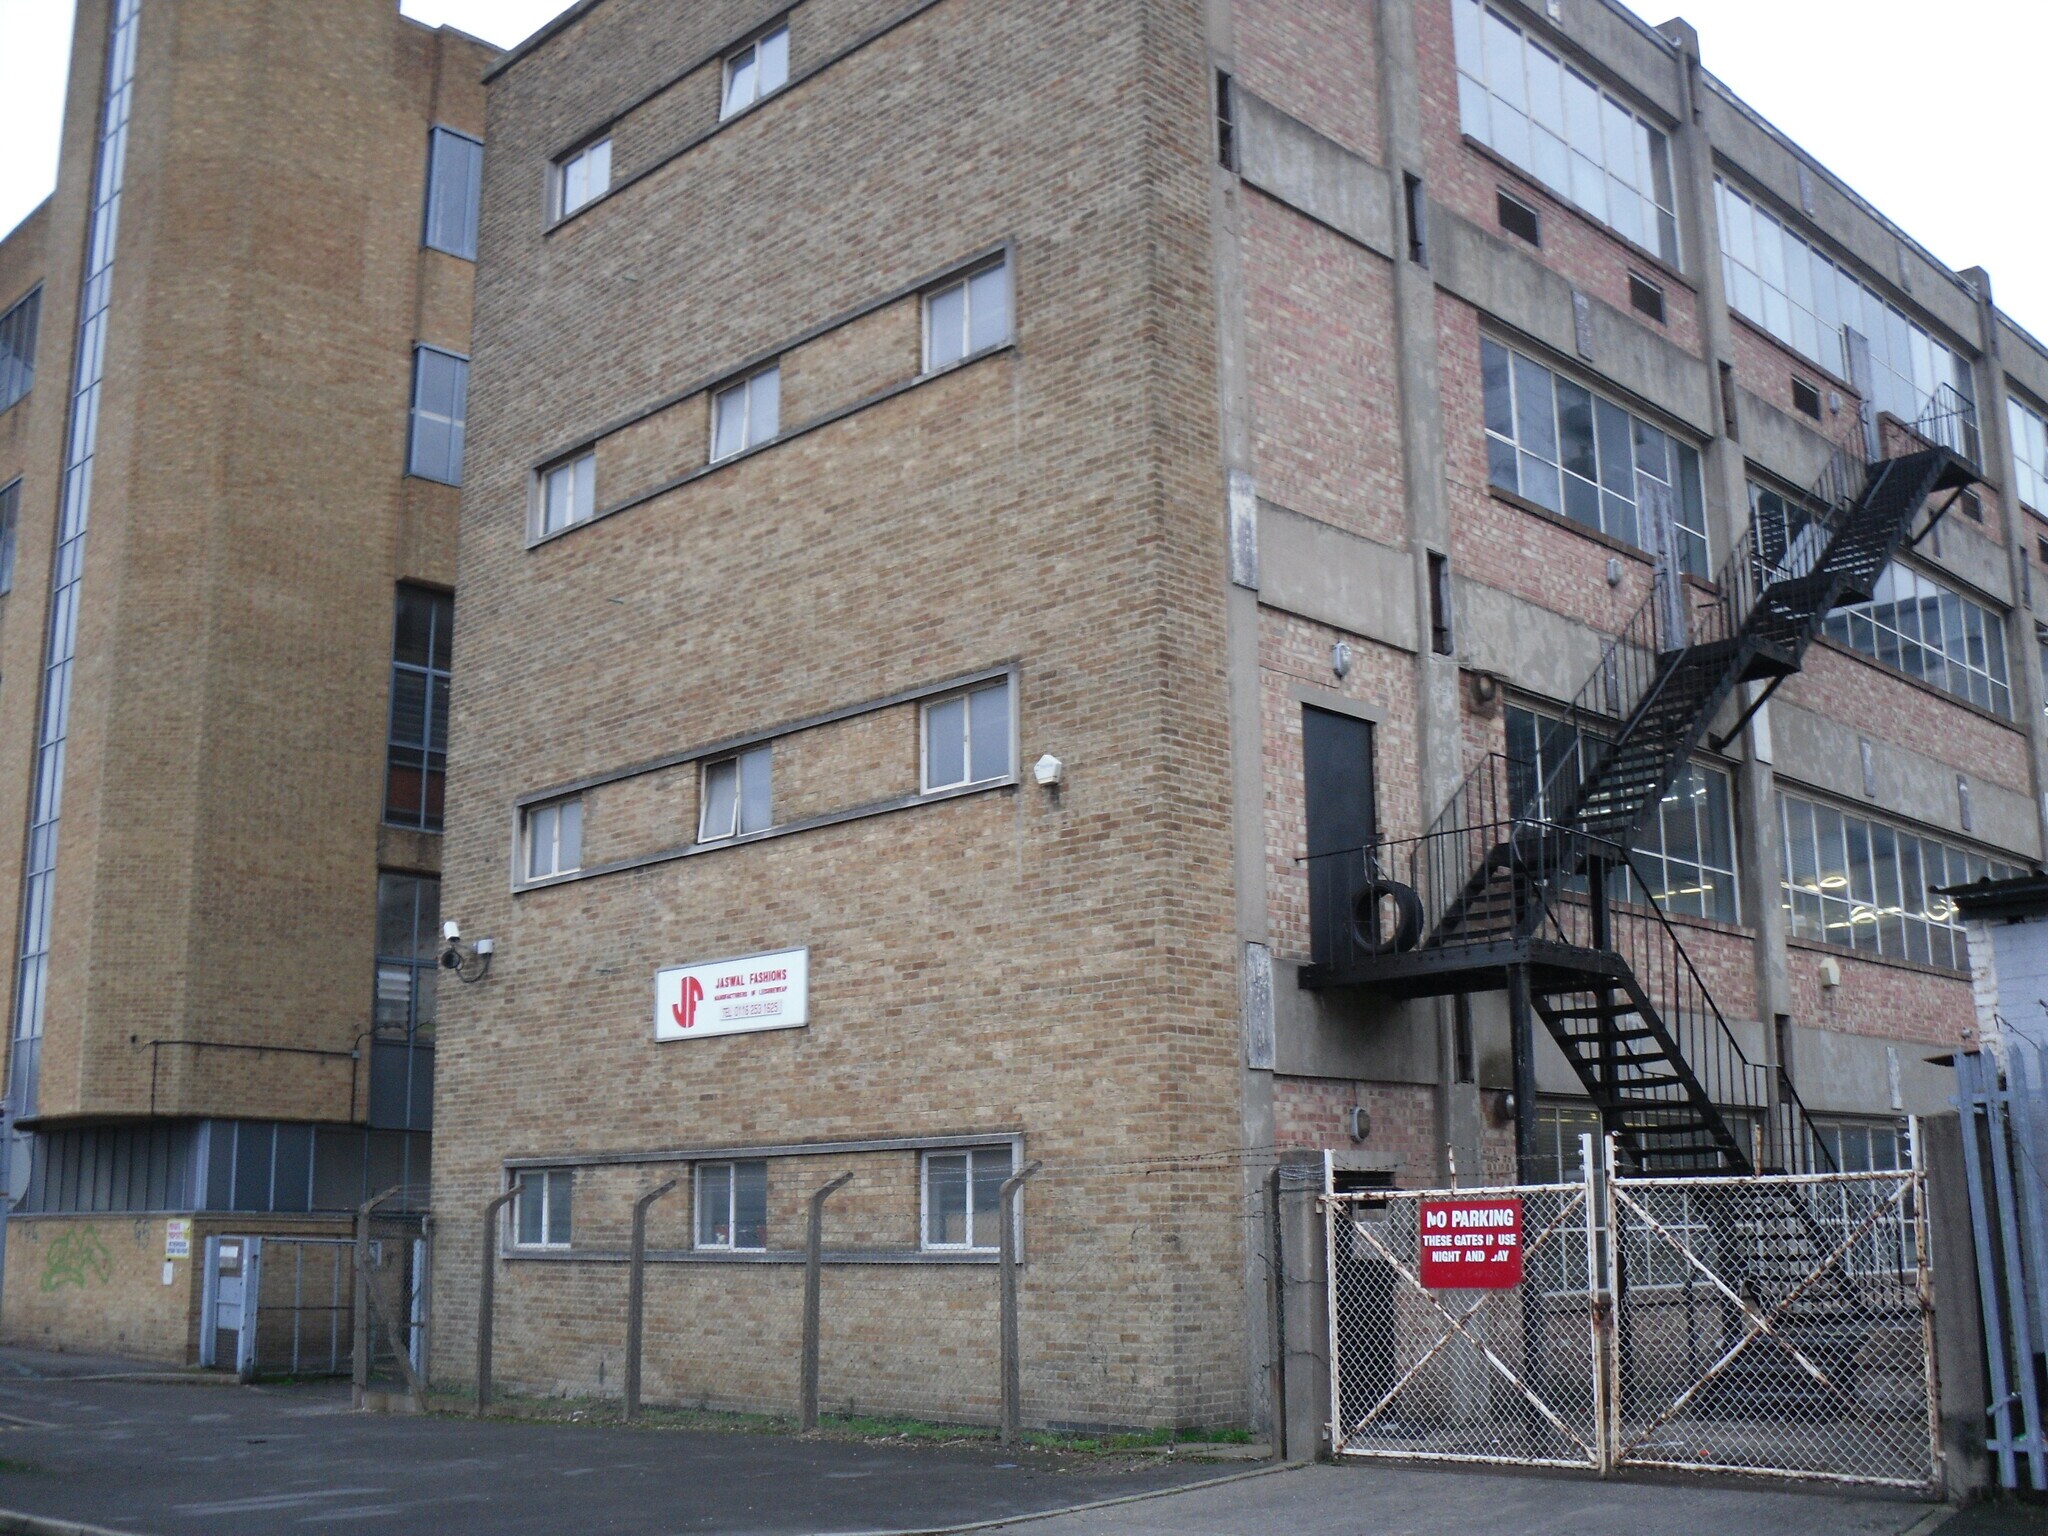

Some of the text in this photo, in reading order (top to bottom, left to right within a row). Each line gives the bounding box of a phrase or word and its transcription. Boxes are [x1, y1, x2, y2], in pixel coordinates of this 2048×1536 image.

[716, 969, 787, 989] JASWAL FASHIONS
[1426, 1209, 1514, 1228] NO PARKING
[1423, 1234, 1453, 1247] THESE
[1454, 1234, 1484, 1246] GATES
[1498, 1234, 1517, 1246] USE
[1432, 1250, 1461, 1263] NIGHT
[1465, 1250, 1486, 1262] AND
